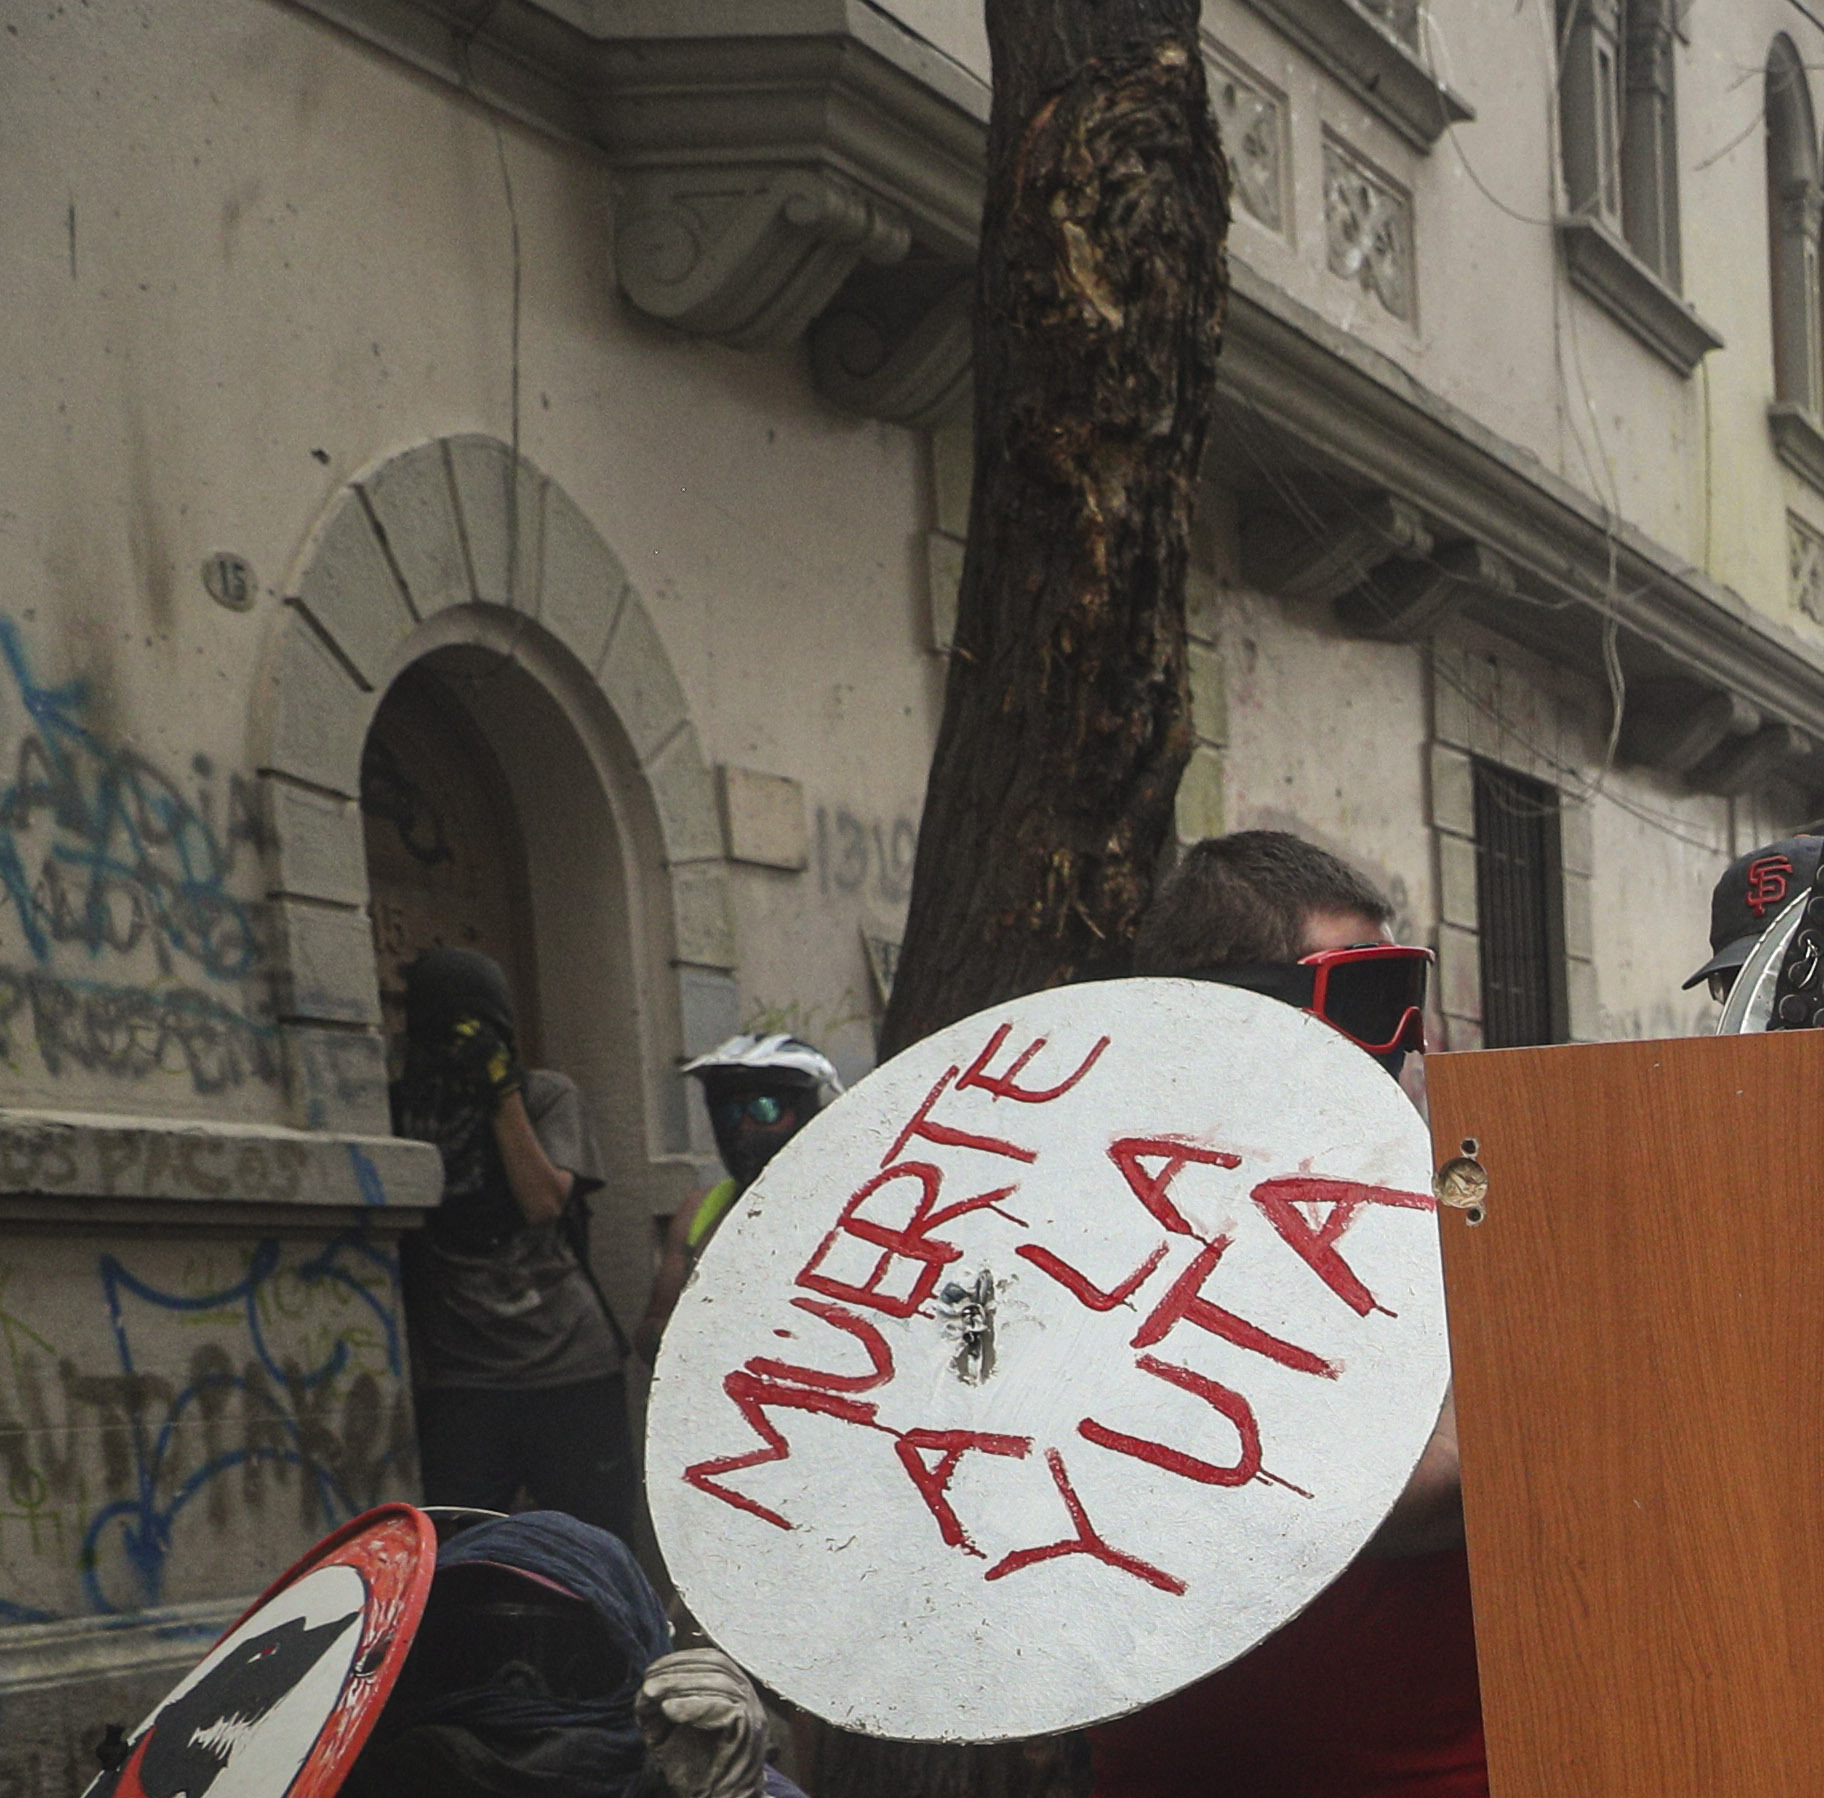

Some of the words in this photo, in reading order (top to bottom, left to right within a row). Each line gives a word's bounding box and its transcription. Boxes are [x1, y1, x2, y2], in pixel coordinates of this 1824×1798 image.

[218, 560, 249, 602] 15
[682, 1022, 1111, 1530] MUERTE
[894, 1428, 1032, 1558] A
[1016, 1135, 1243, 1313] LA
[985, 1174, 1437, 1598] YUTA
